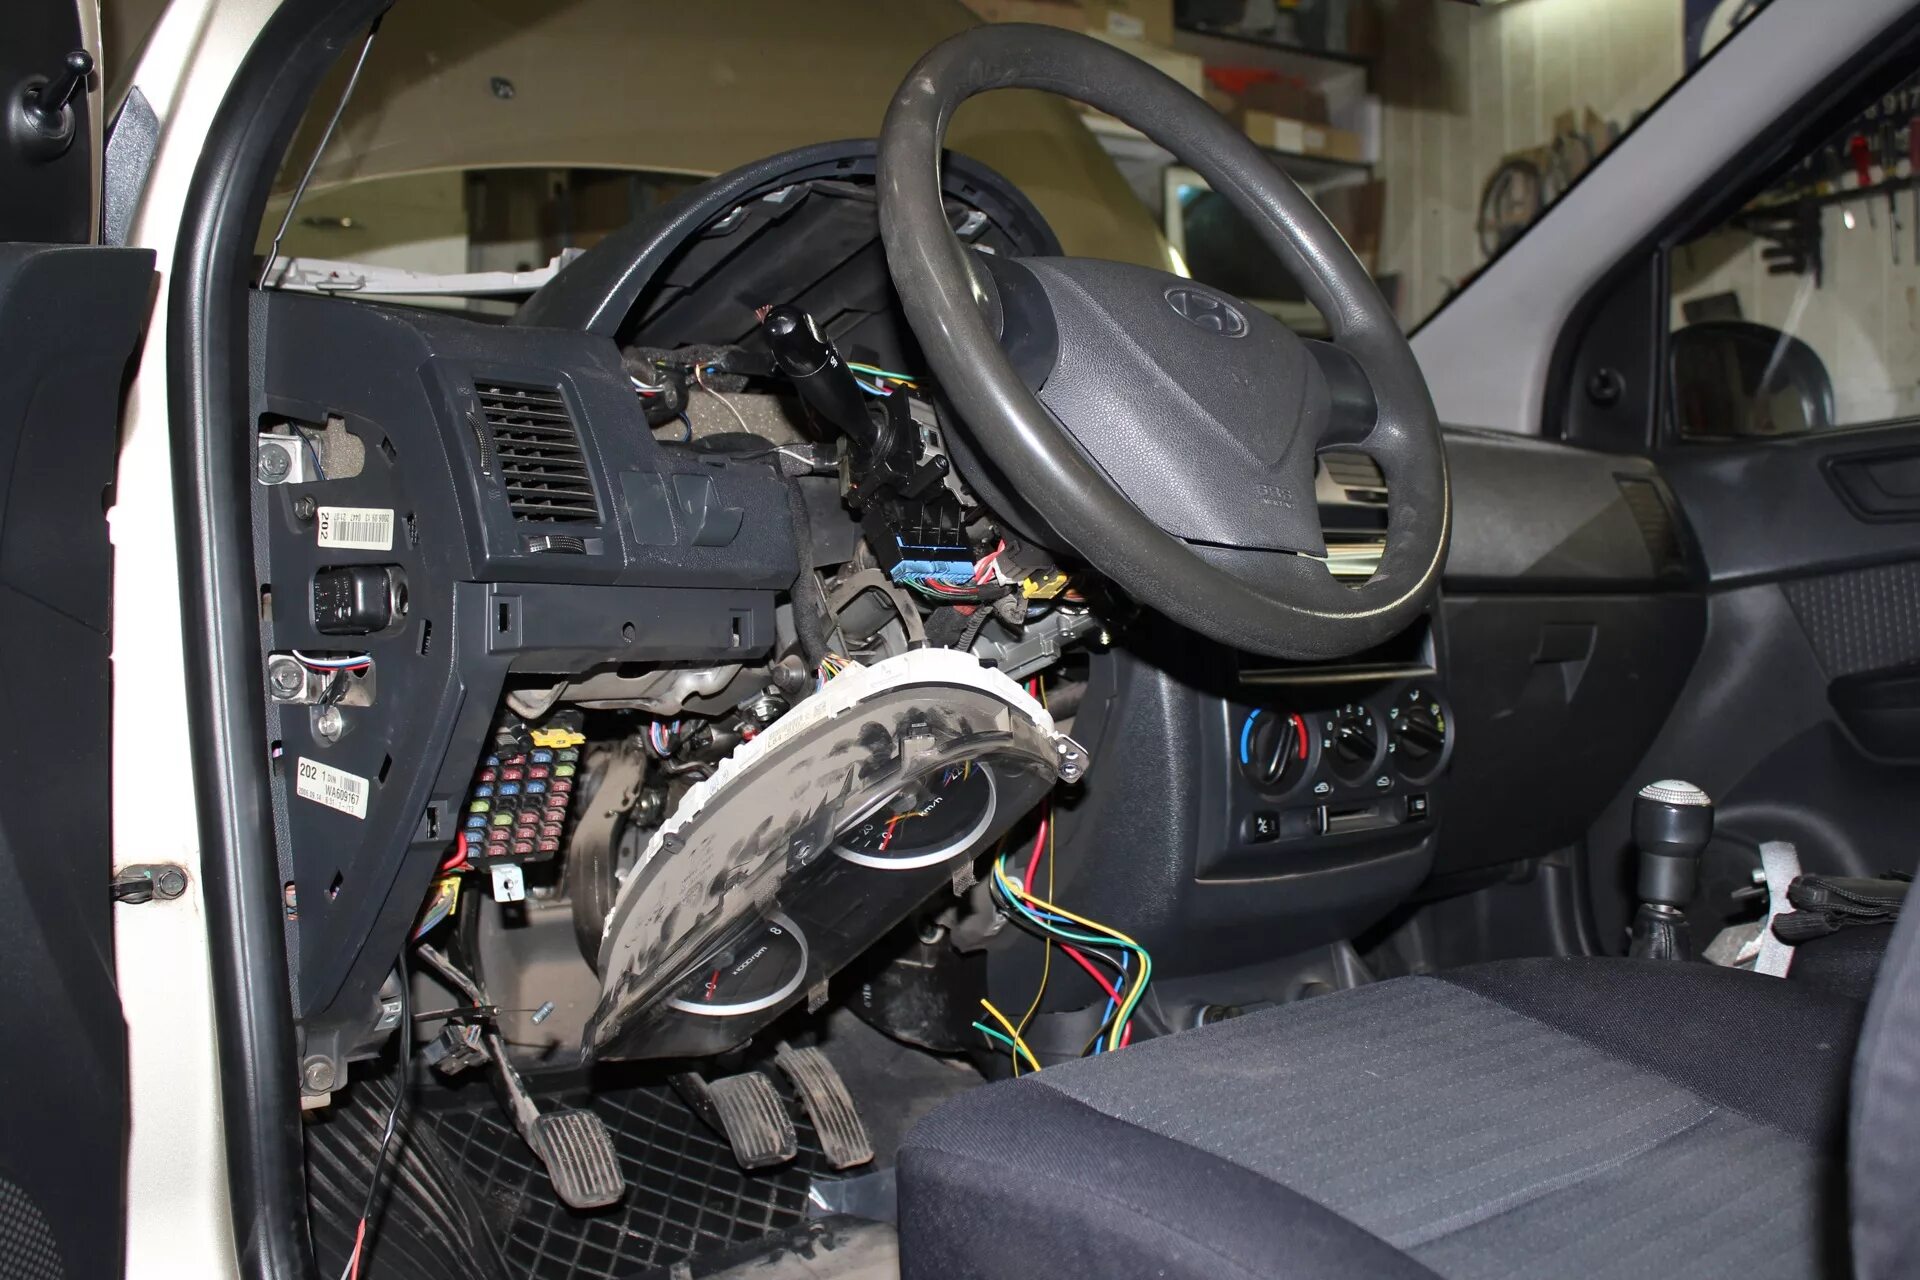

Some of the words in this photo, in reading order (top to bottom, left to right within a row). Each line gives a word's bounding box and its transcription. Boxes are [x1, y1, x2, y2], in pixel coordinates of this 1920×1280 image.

[320, 512, 330, 540] 202
[1345, 703, 1352, 713] 2
[1357, 705, 1364, 716] 3
[1335, 709, 1341, 718] 1
[1326, 721, 1333, 731] 0
[300, 763, 317, 780] 202
[918, 796, 943, 817] km/h
[769, 926, 782, 935] 8
